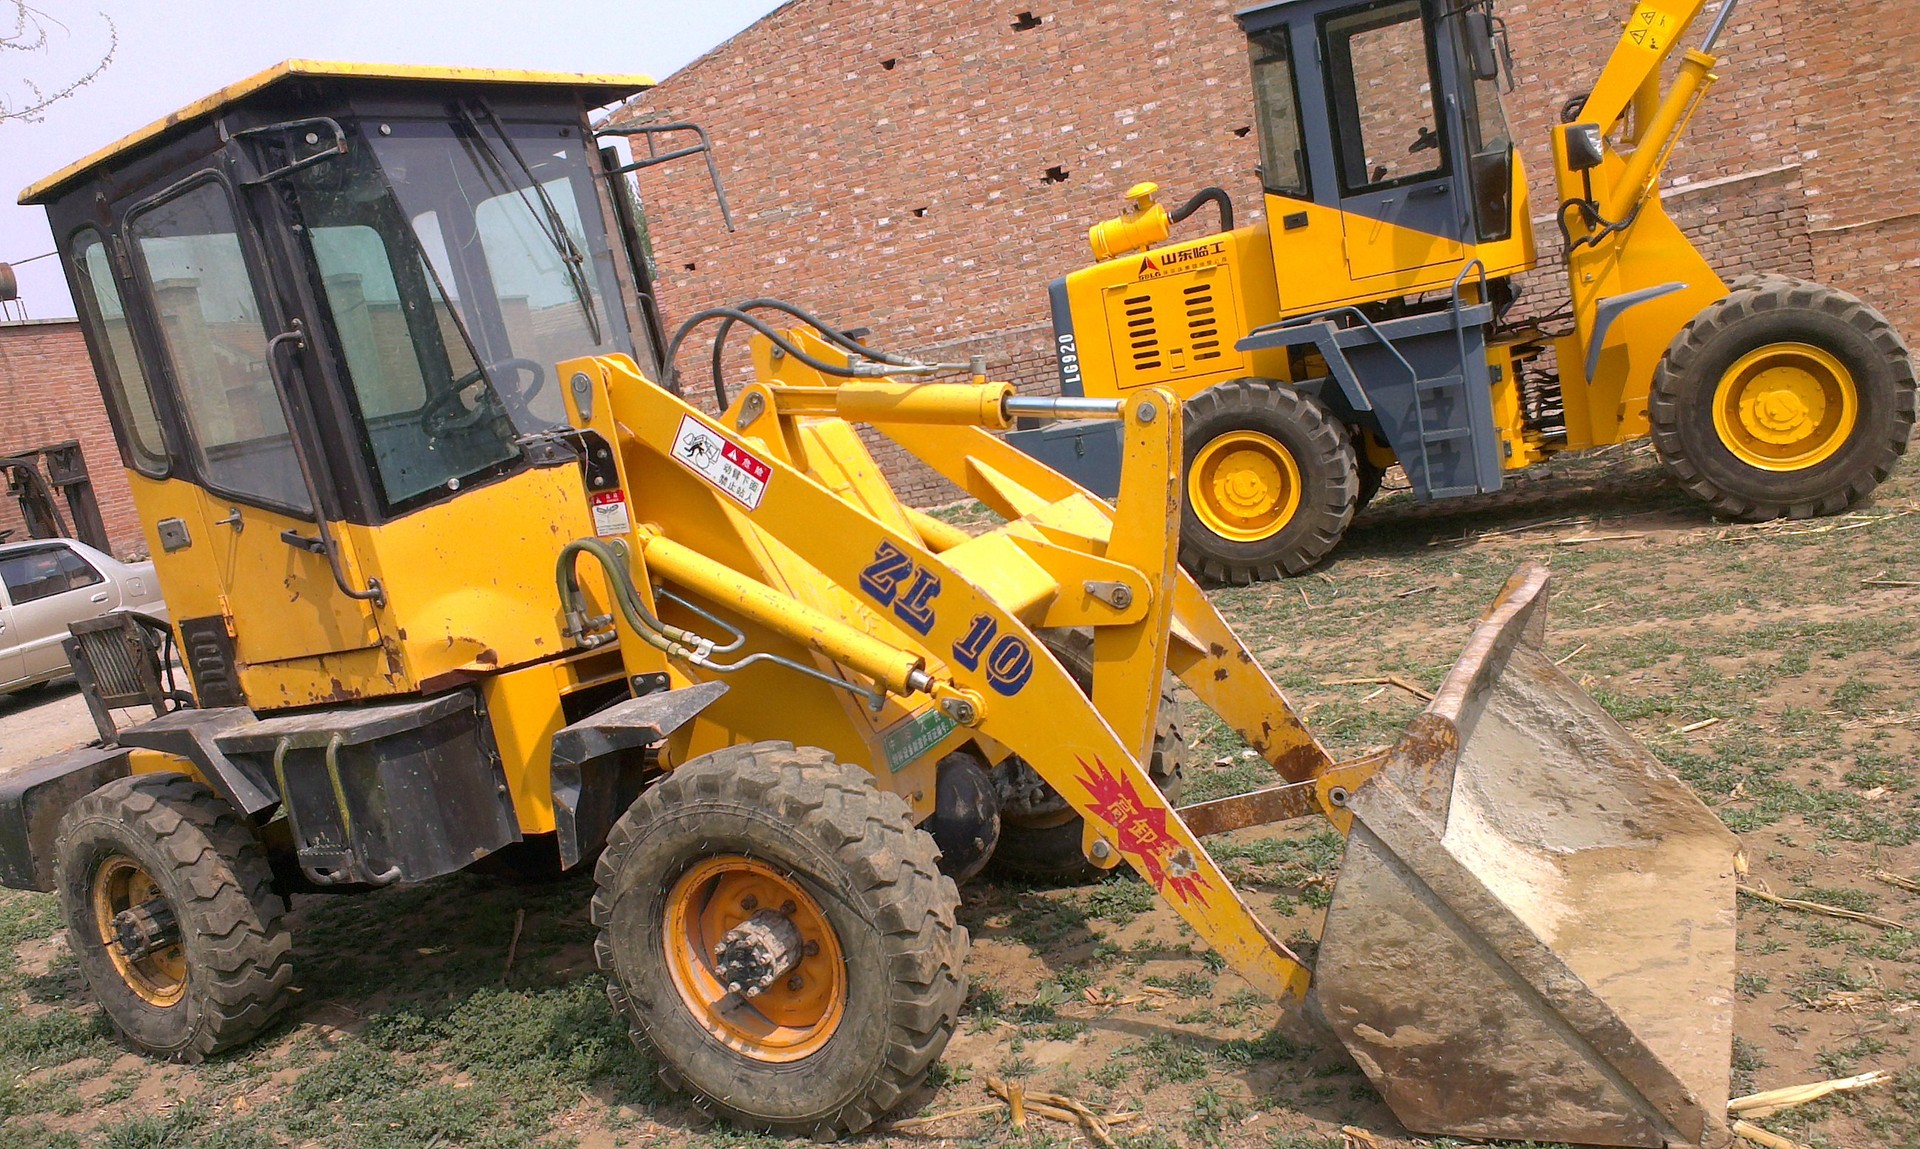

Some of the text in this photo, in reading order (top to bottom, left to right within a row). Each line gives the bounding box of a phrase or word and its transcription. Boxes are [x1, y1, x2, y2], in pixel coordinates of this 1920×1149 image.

[1161, 241, 1226, 266] 山东临工
[1058, 334, 1081, 383] LG920
[723, 463, 759, 492] 动臂下面
[742, 458, 764, 477] 危险
[719, 475, 753, 505] 禁止站人
[859, 536, 1034, 697] ZL 10
